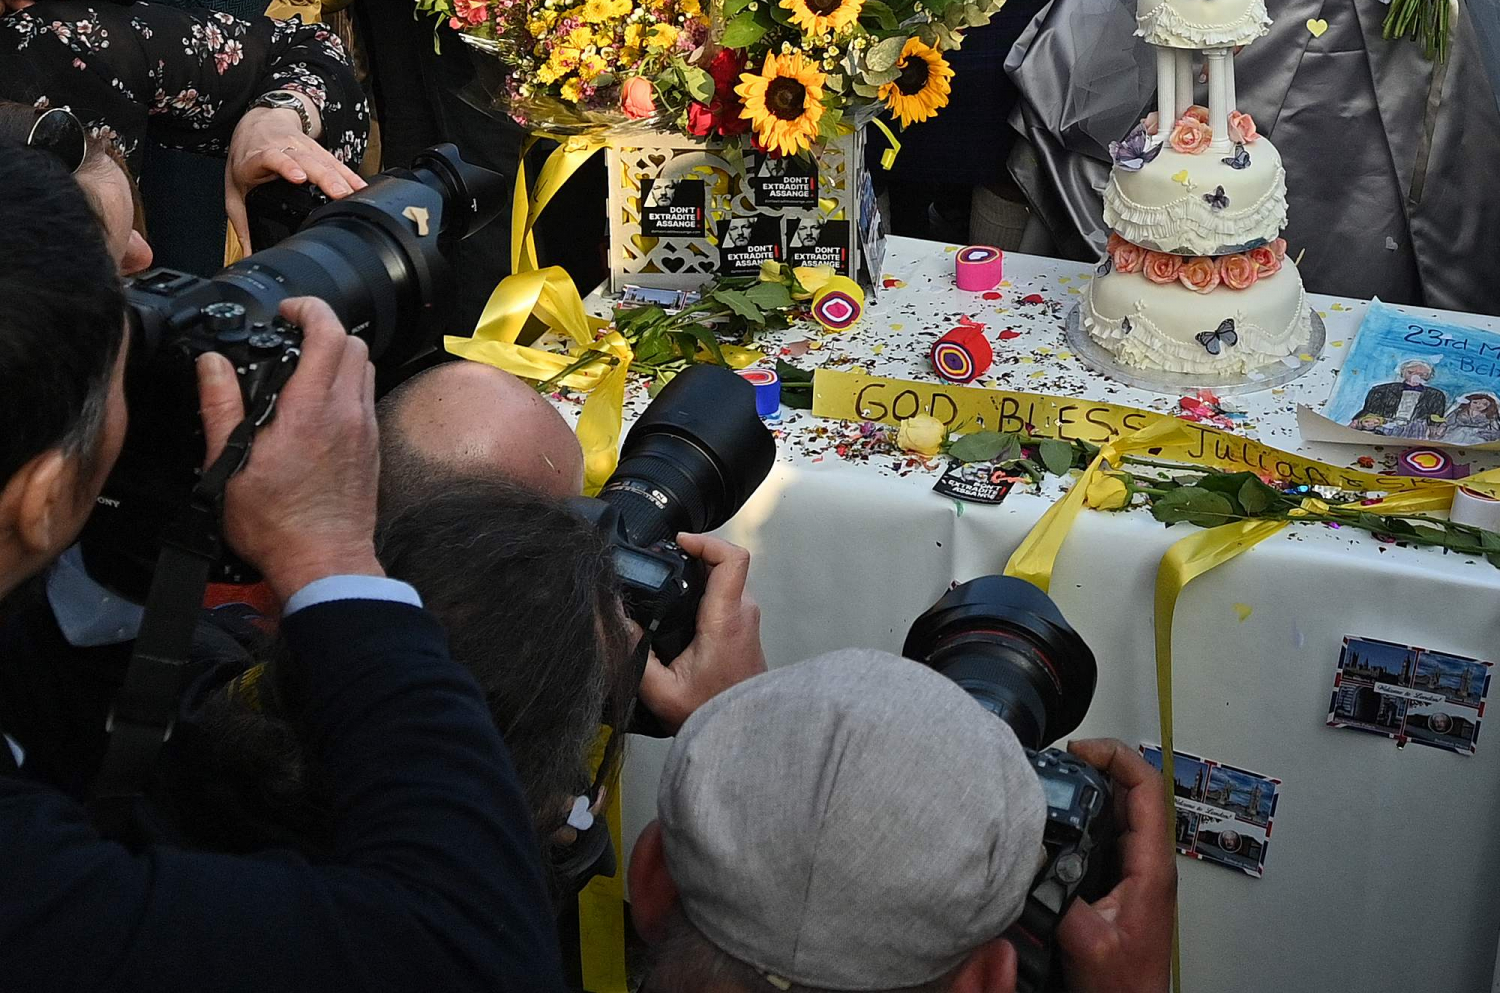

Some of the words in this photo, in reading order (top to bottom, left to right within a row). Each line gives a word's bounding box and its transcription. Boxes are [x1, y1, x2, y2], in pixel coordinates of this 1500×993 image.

[783, 176, 810, 184] DON'T
[762, 183, 810, 191] EXTRADITE
[769, 190, 810, 198] ASSANGE
[649, 213, 696, 221] EXTRADITE
[656, 220, 696, 228] ASSANGE
[747, 244, 773, 253] DON'T
[727, 251, 774, 260] EXTRADITE
[794, 253, 840, 261] EXTRADITE
[1404, 324, 1468, 351] 23rd
[855, 383, 958, 427] GOD
[97, 497, 120, 508] ONY
